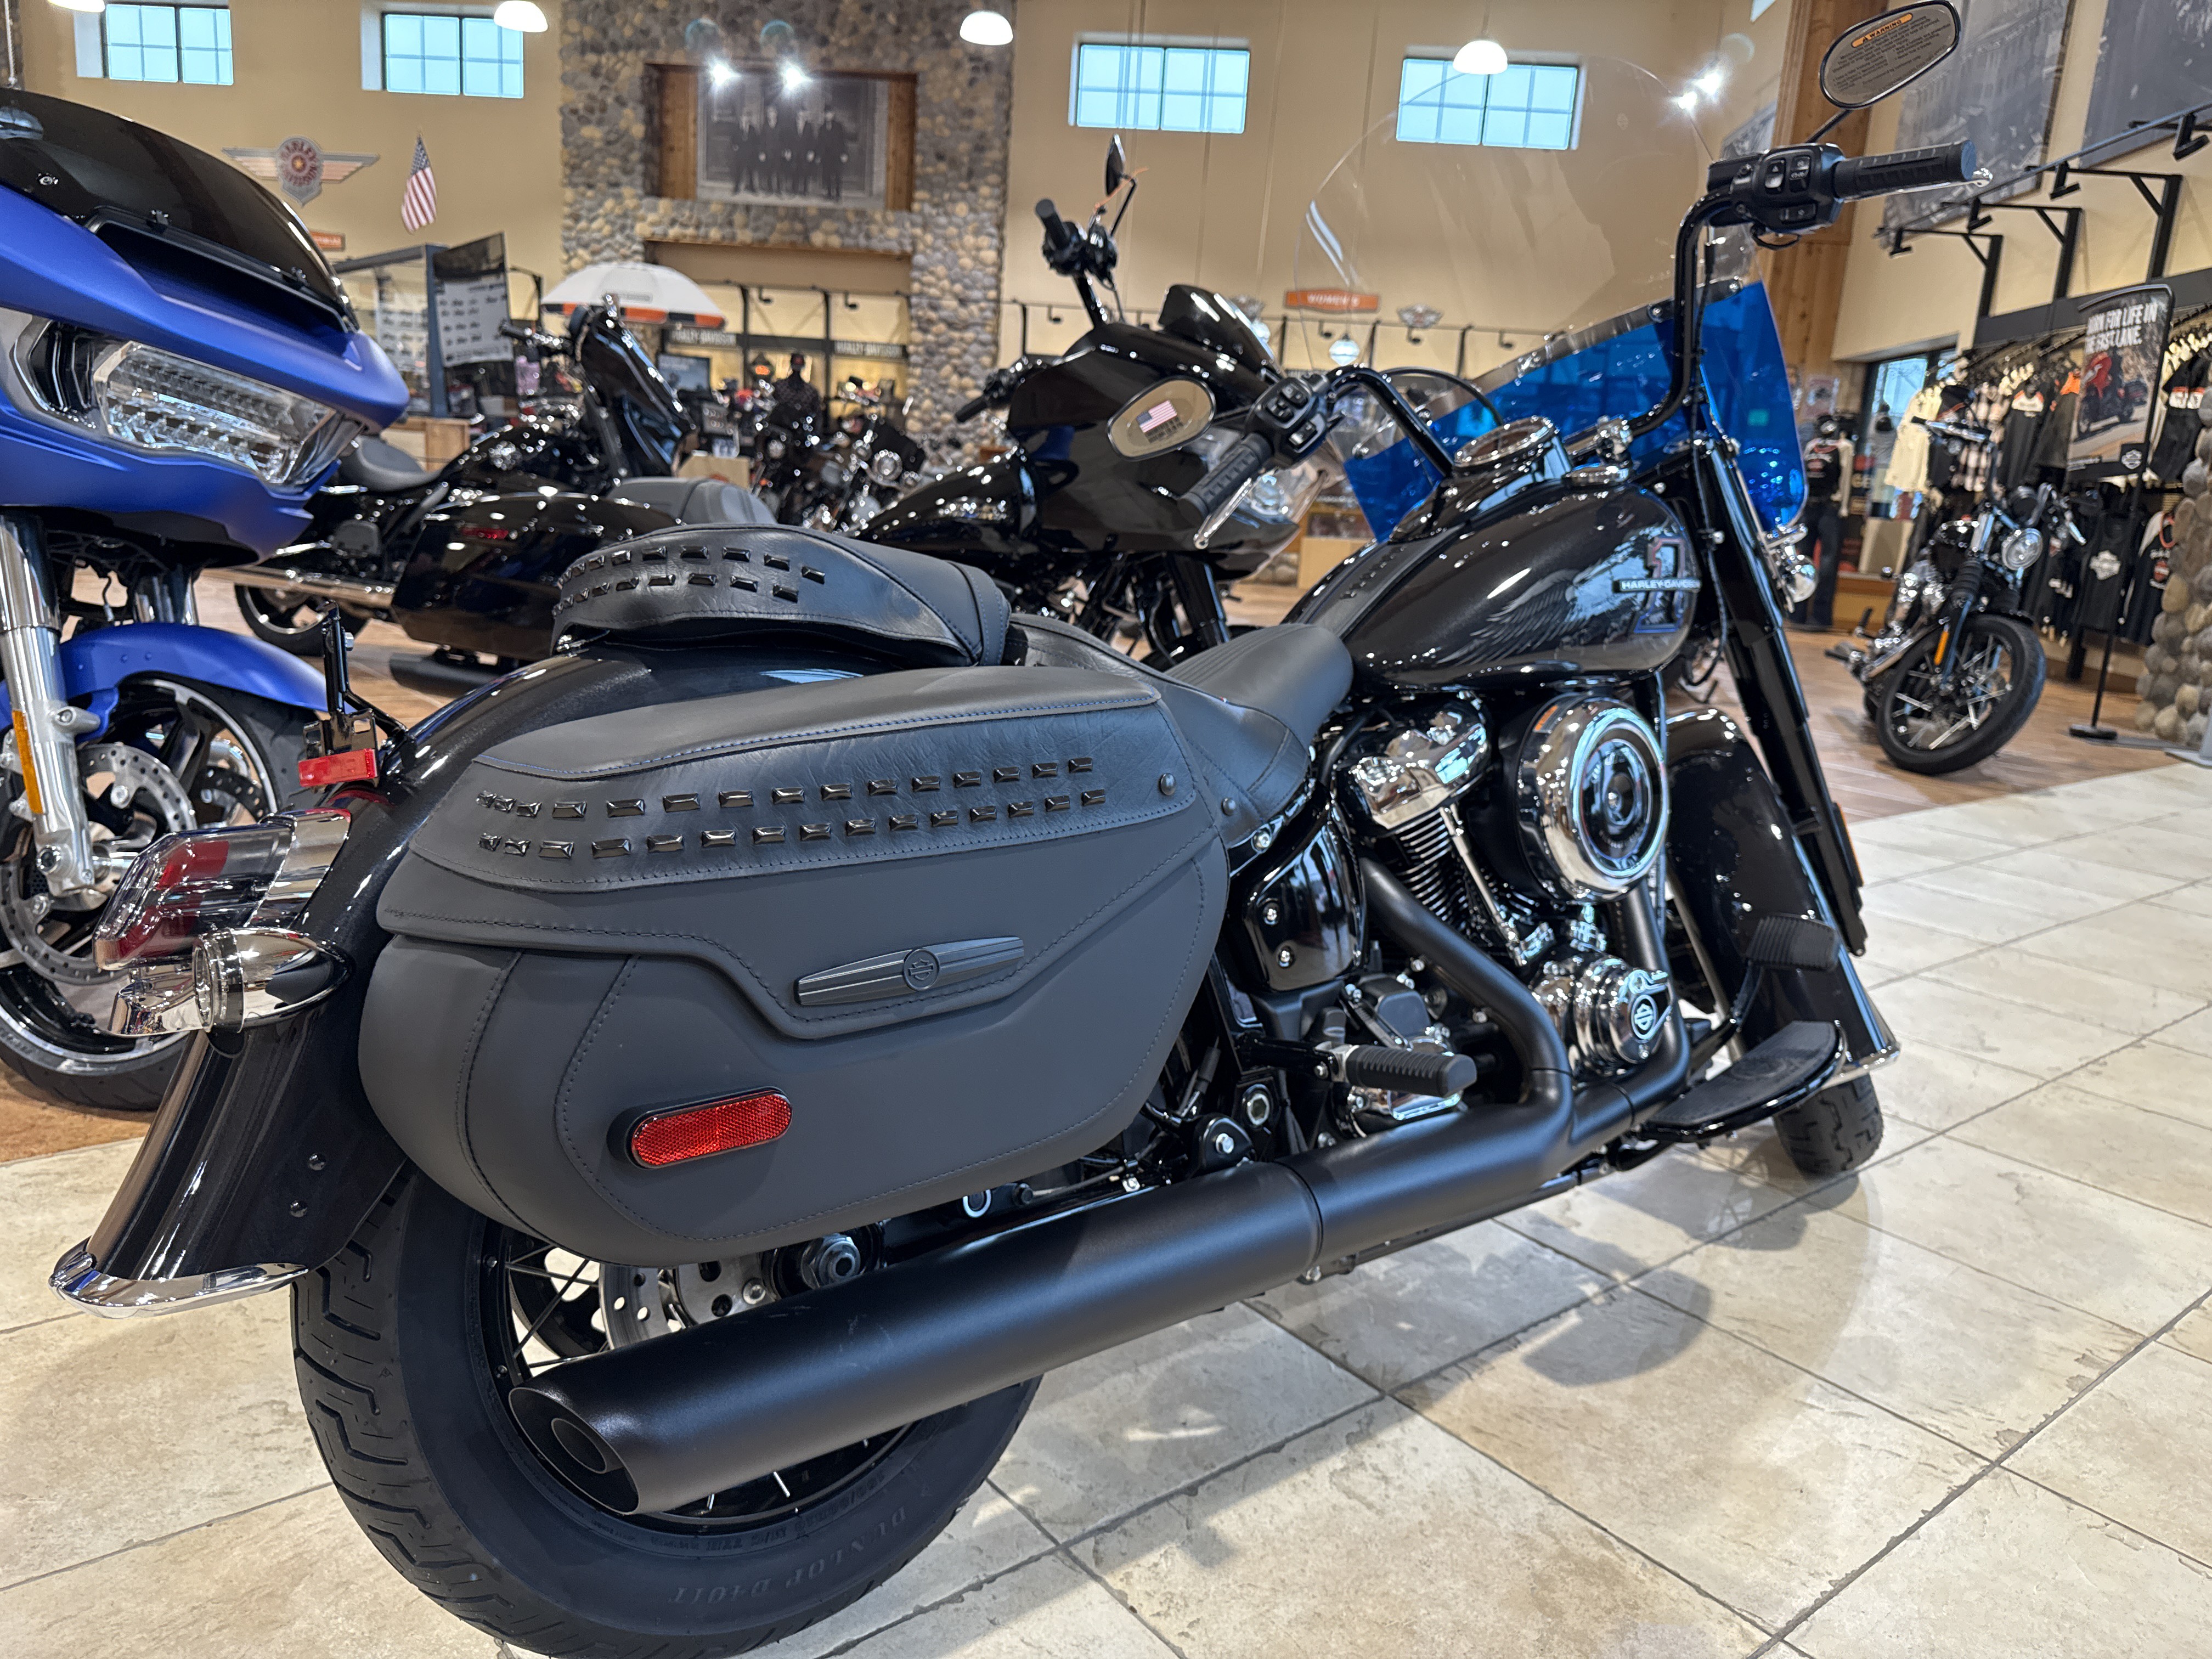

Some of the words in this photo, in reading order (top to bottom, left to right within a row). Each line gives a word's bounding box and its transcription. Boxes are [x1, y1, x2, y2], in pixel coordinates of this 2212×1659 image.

[1869, 19, 1902, 38] WARNING
[2106, 308, 2123, 331] FOR
[2122, 303, 2144, 326] LIFE
[2143, 302, 2158, 324] IN
[785, 1505, 906, 1587] DUNLOP
